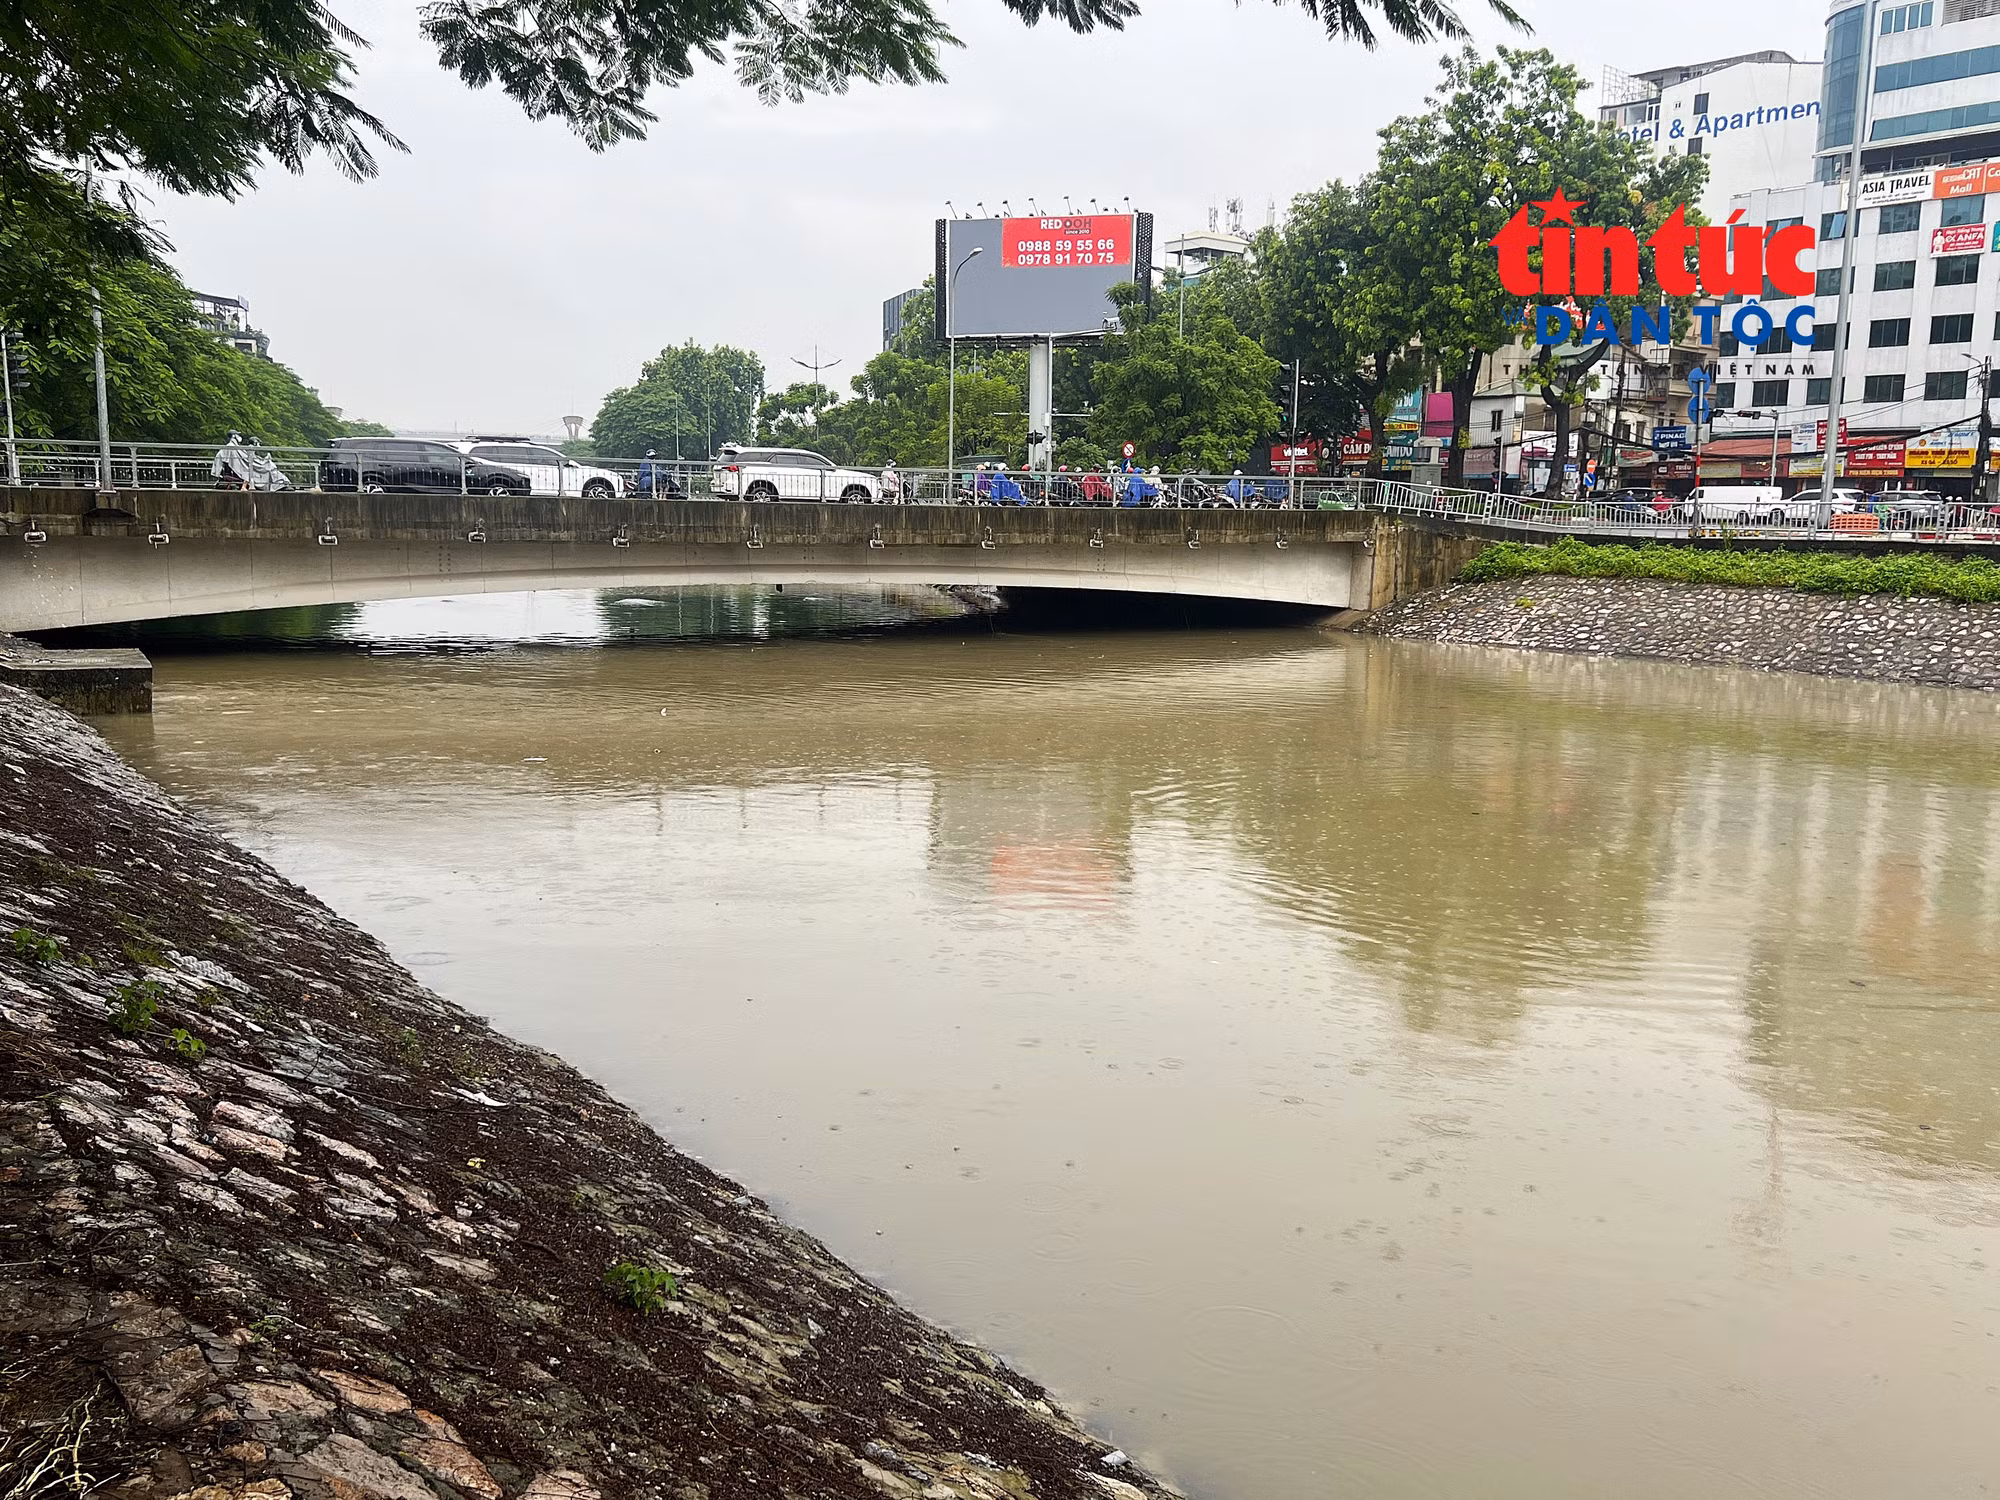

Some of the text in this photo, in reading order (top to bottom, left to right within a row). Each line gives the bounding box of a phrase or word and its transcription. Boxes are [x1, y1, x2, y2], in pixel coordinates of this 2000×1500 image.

[1616, 100, 1821, 143] otel & Apartmen
[1862, 175, 1932, 194] ASIA TRAVEL
[1950, 183, 1973, 195] Mall
[1018, 239, 1115, 252] 0988 59 55 66
[1018, 252, 1114, 265] 0978 91 70 75
[1283, 446, 1308, 457] vittel
